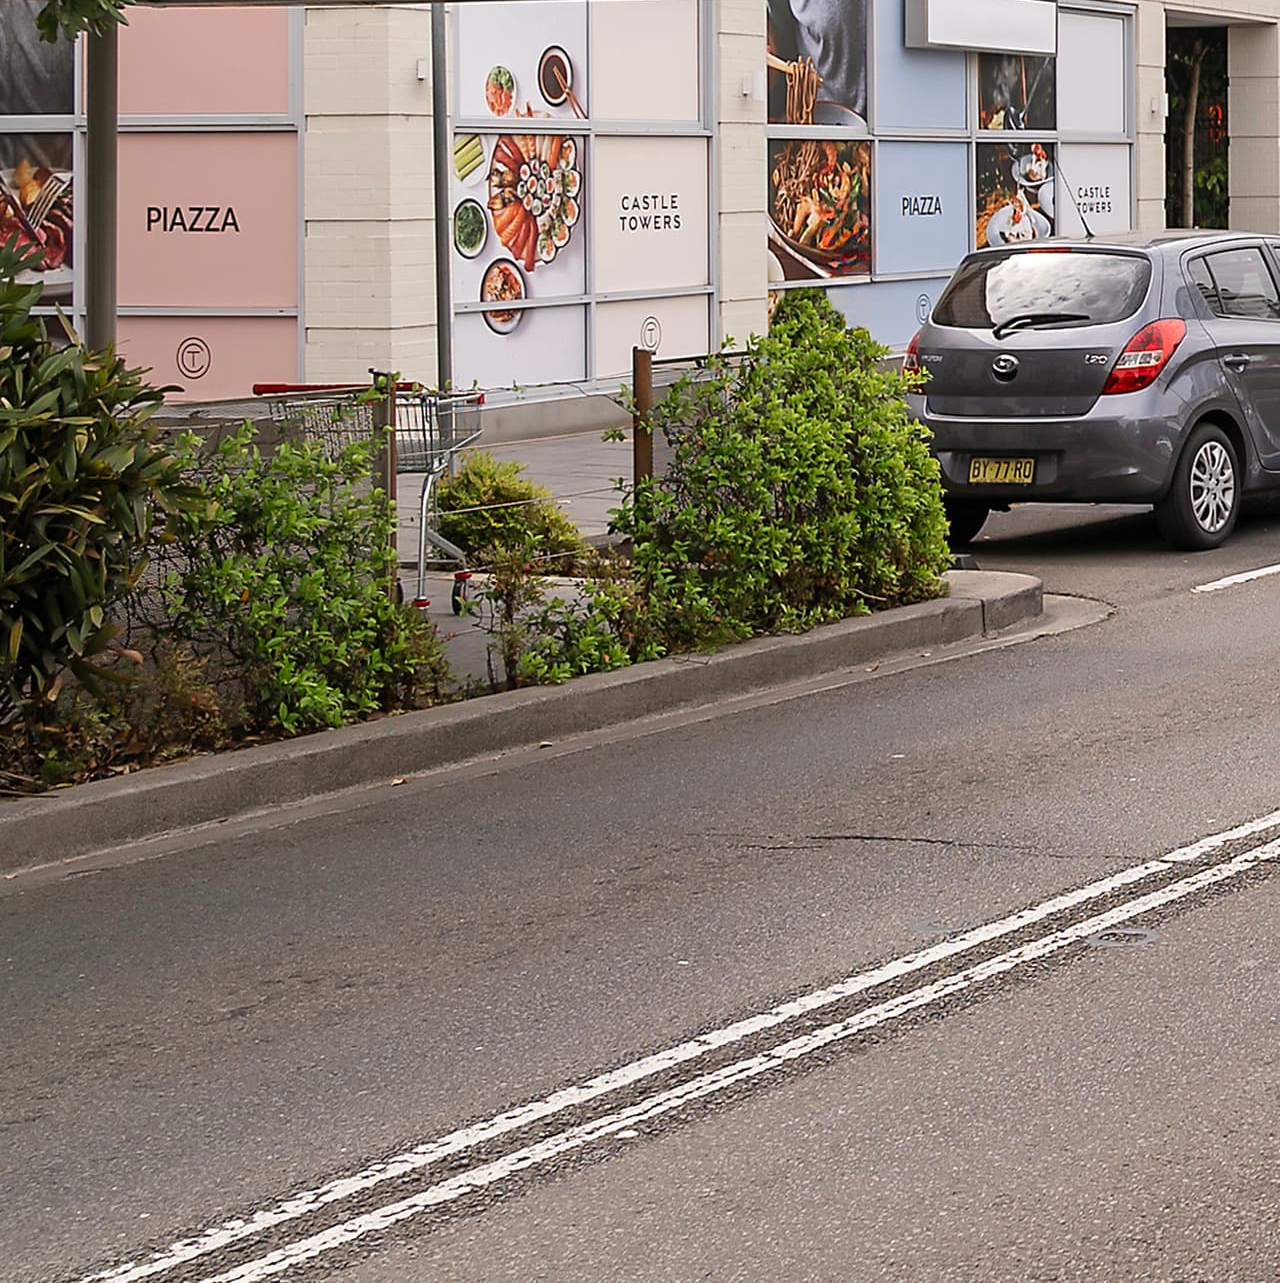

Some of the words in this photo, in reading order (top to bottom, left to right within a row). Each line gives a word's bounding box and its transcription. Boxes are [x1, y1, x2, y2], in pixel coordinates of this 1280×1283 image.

[1078, 187, 1110, 198] CASTLE
[621, 195, 678, 210] CASTLE
[902, 197, 942, 216] PIAZZA
[1077, 202, 1111, 213] TOWERS
[147, 207, 240, 232] PIAZZA
[619, 215, 681, 231] TOWERS
